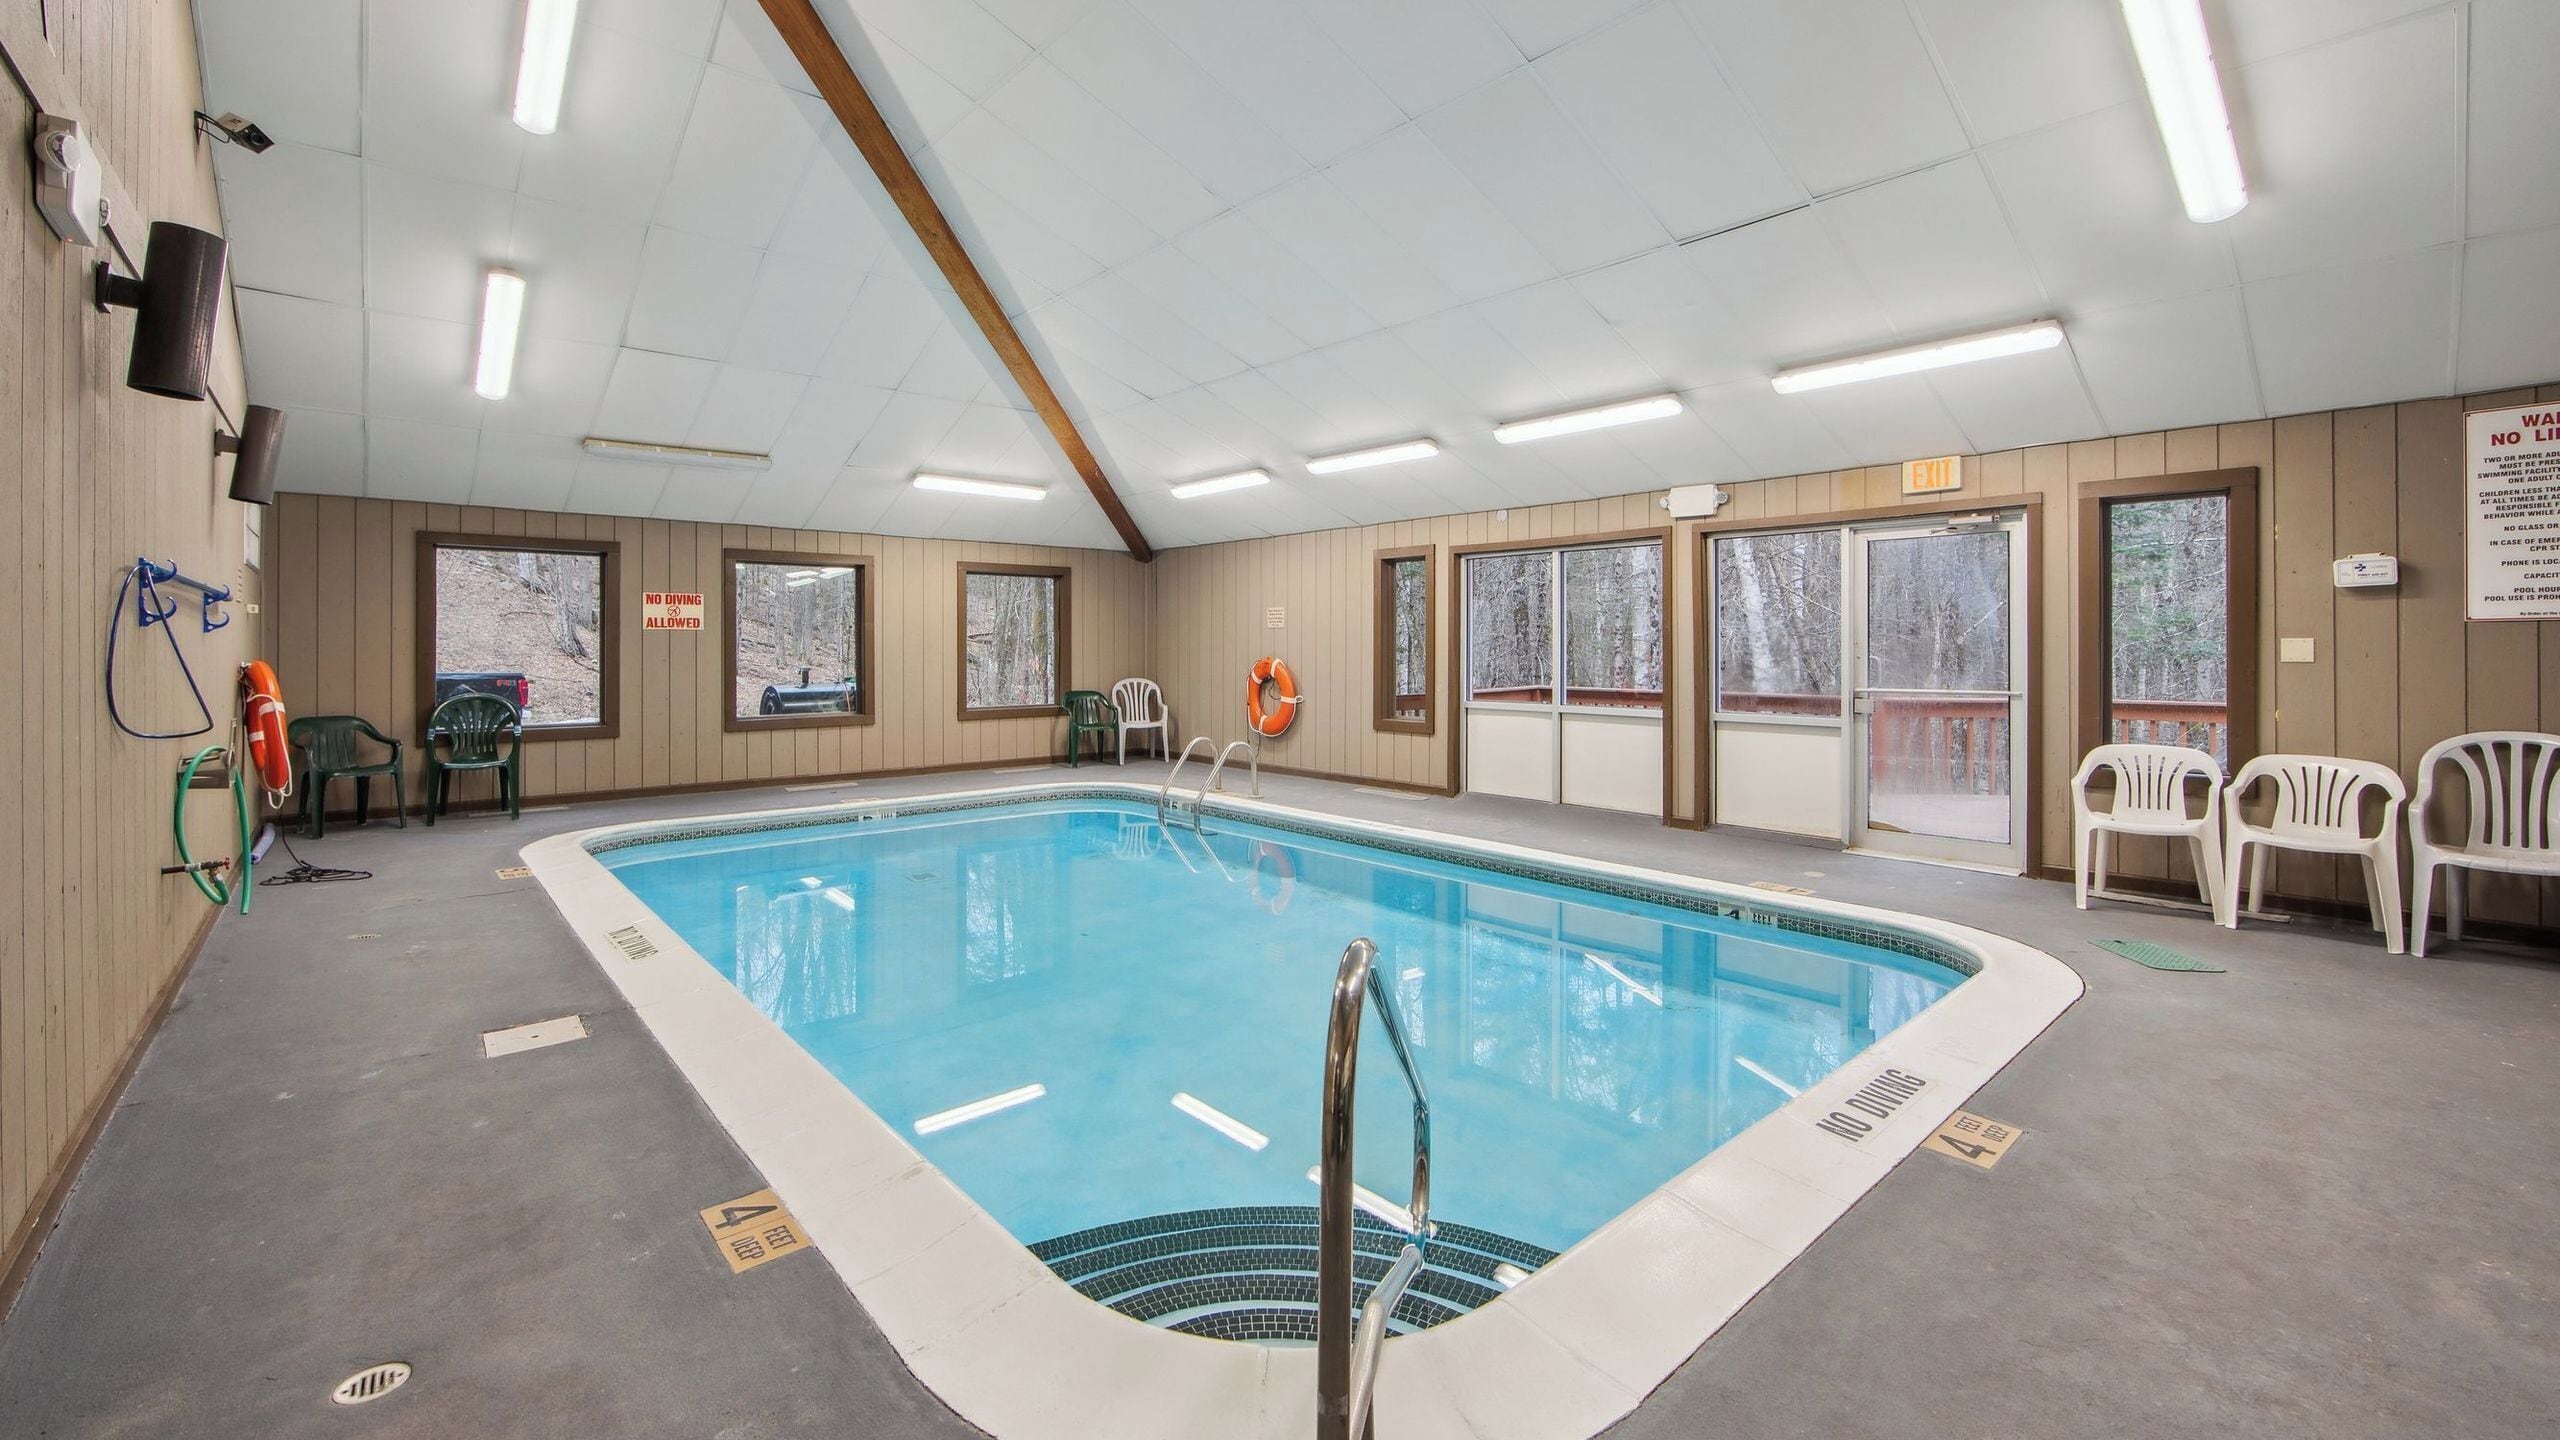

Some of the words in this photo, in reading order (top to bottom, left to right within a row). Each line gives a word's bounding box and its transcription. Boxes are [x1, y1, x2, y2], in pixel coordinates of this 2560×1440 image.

[2491, 431, 2521, 446] NO
[2518, 452, 2542, 460] MORE
[1912, 458, 1951, 490] EXIT
[2477, 469, 2522, 479] SWIMMING
[2479, 489, 2520, 498] CHILDREN
[2495, 502, 2552, 511] RESPONSIBLE
[2483, 511, 2525, 520] BEHAVIOR
[2527, 509, 2555, 517] WHILE
[2518, 523, 2545, 531] GLASS
[645, 593, 662, 605] NO
[665, 594, 702, 606] DIVING
[646, 617, 700, 628] ALLOWED
[1816, 1111, 1873, 1143] NO
[1845, 1068, 1926, 1120] DIVING
[1954, 1115, 1983, 1134] FEET
[1981, 1124, 2010, 1142] DEEP
[1938, 1134, 1996, 1159] 4
[715, 1205, 778, 1230] 4
[762, 1224, 798, 1250] FEET
[730, 1235, 766, 1261] DEEP
